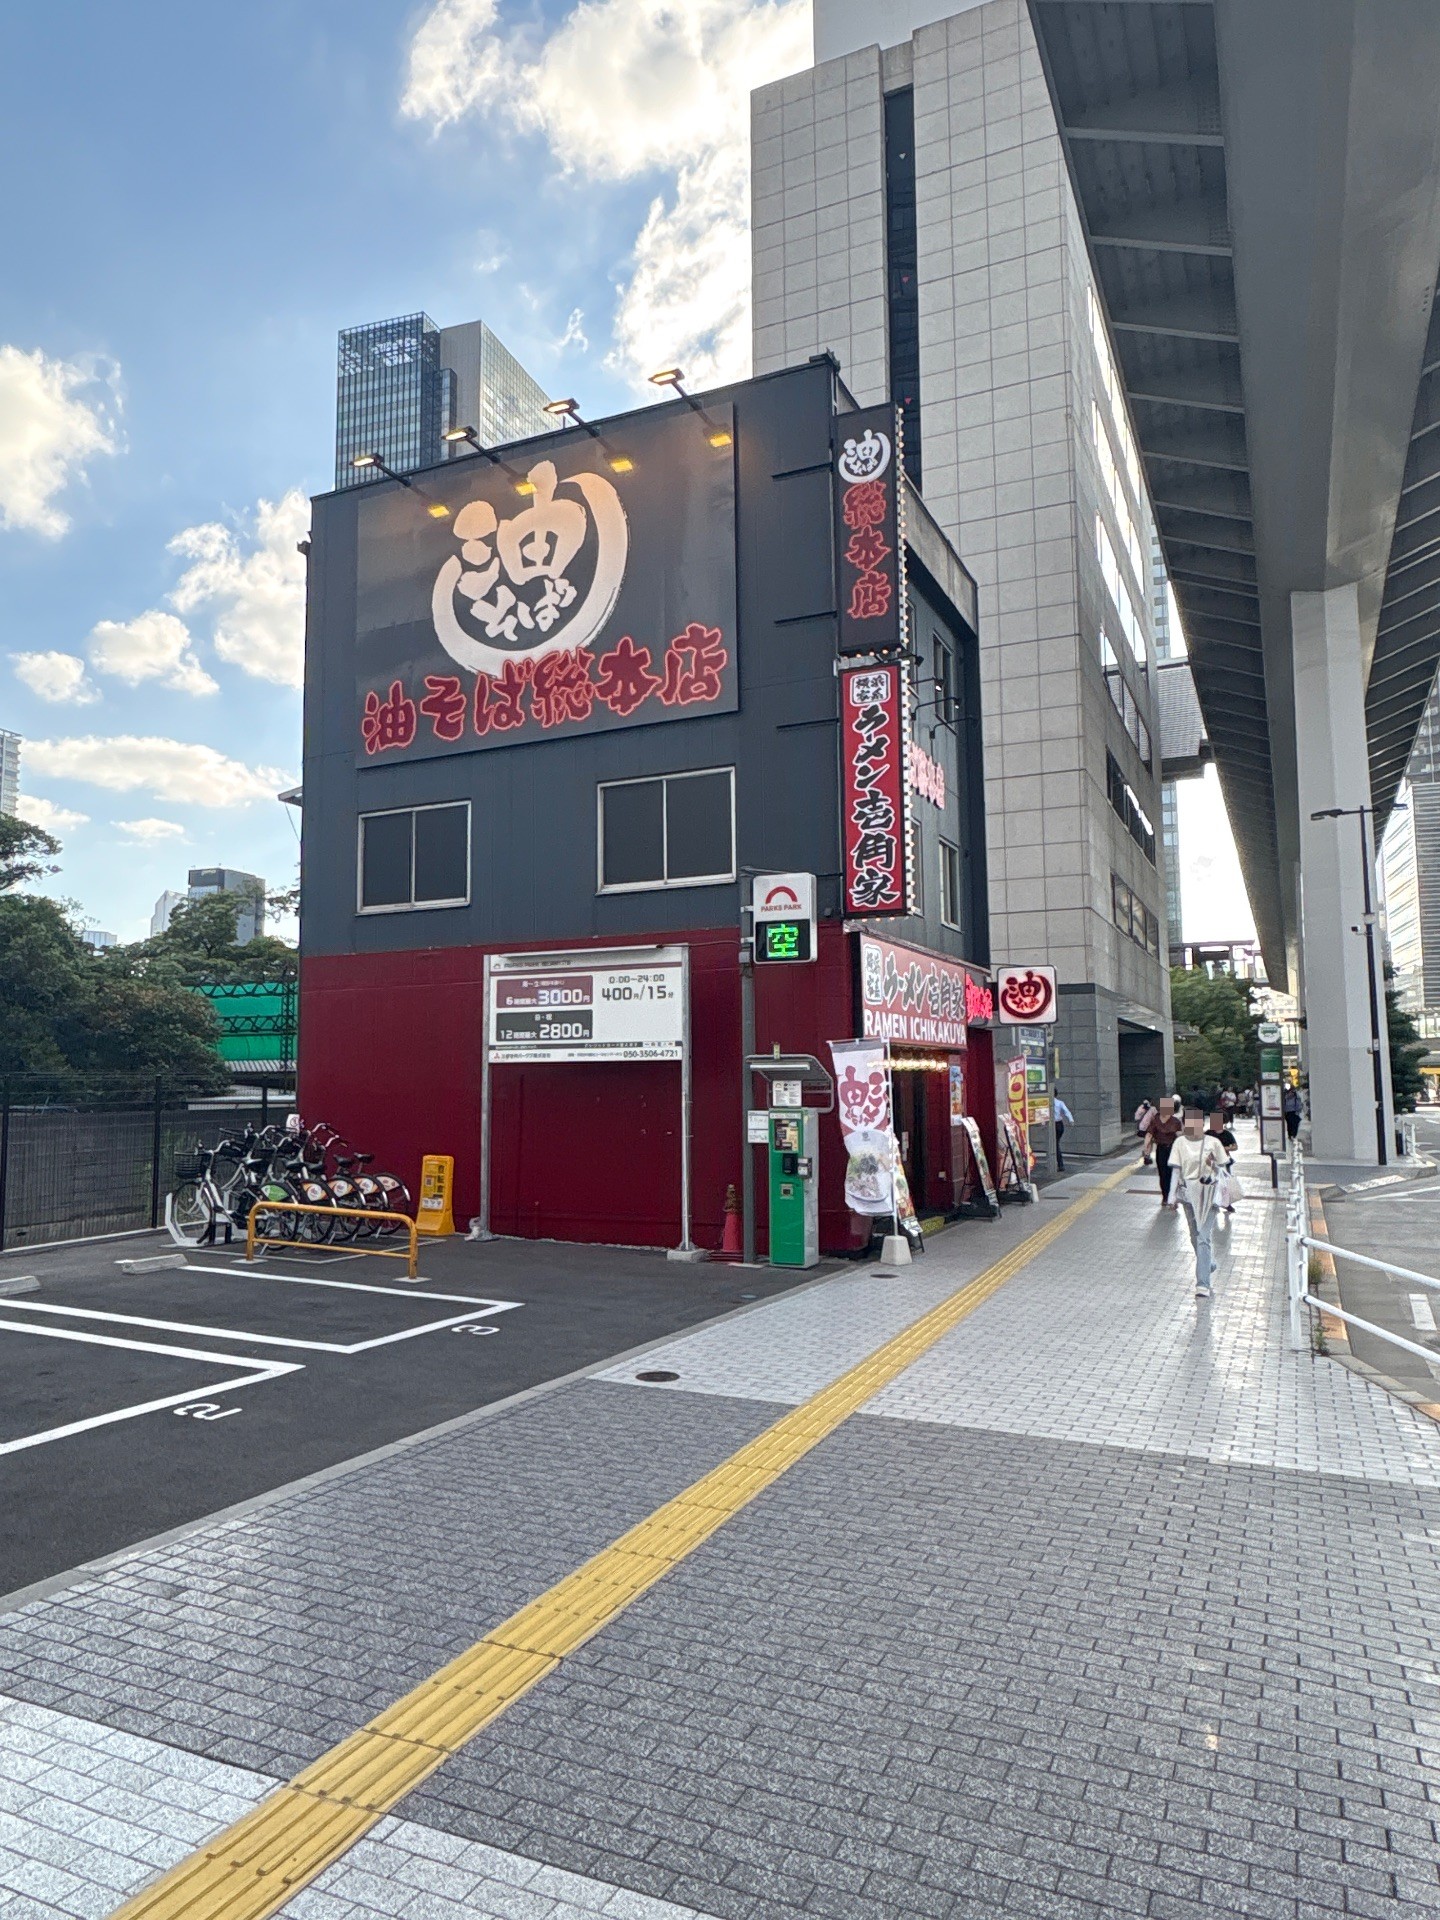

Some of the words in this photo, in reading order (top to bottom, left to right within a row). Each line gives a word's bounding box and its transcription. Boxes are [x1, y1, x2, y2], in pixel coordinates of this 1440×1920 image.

[844, 429, 881, 464] 油
[453, 460, 587, 600] 油
[843, 481, 892, 619] 総本店
[470, 578, 577, 641] そば
[360, 623, 729, 755] 油そば総本店
[850, 704, 900, 907] ラーメン壱角家
[784, 903, 802, 911] PARK
[767, 923, 799, 958] 空
[1006, 970, 1041, 999] 油
[864, 1008, 908, 1039] RAMEN
[910, 1017, 967, 1046] ICHIKAKUYA
[173, 1403, 243, 1420] 2
